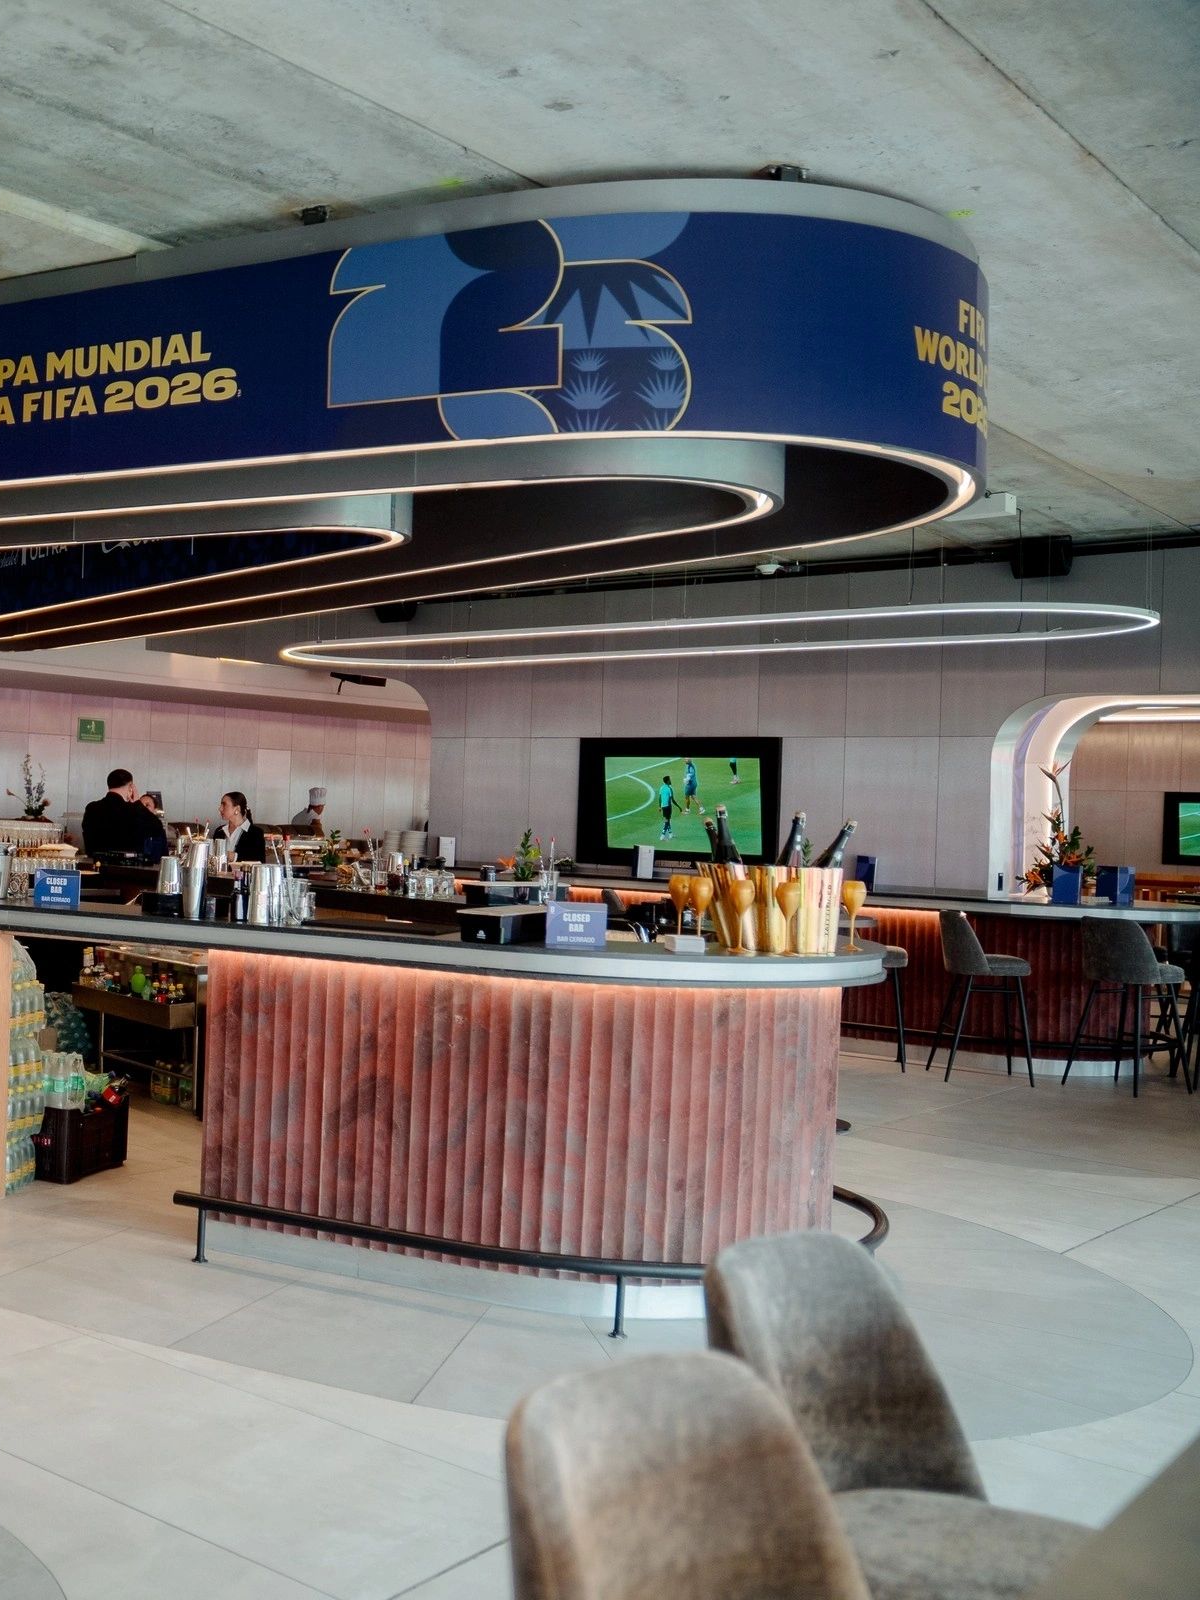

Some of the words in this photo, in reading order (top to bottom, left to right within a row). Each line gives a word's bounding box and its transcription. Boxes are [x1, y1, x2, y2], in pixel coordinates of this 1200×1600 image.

[46, 331, 212, 382] MUNDIAL
[914, 325, 983, 388] WORLD
[22, 385, 97, 423] FIFA
[104, 367, 238, 413] 2026
[46, 877, 68, 886] CLOSED
[50, 886, 62, 894] BAR
[562, 913, 591, 923] CLOSED
[568, 923, 584, 933] BAR
